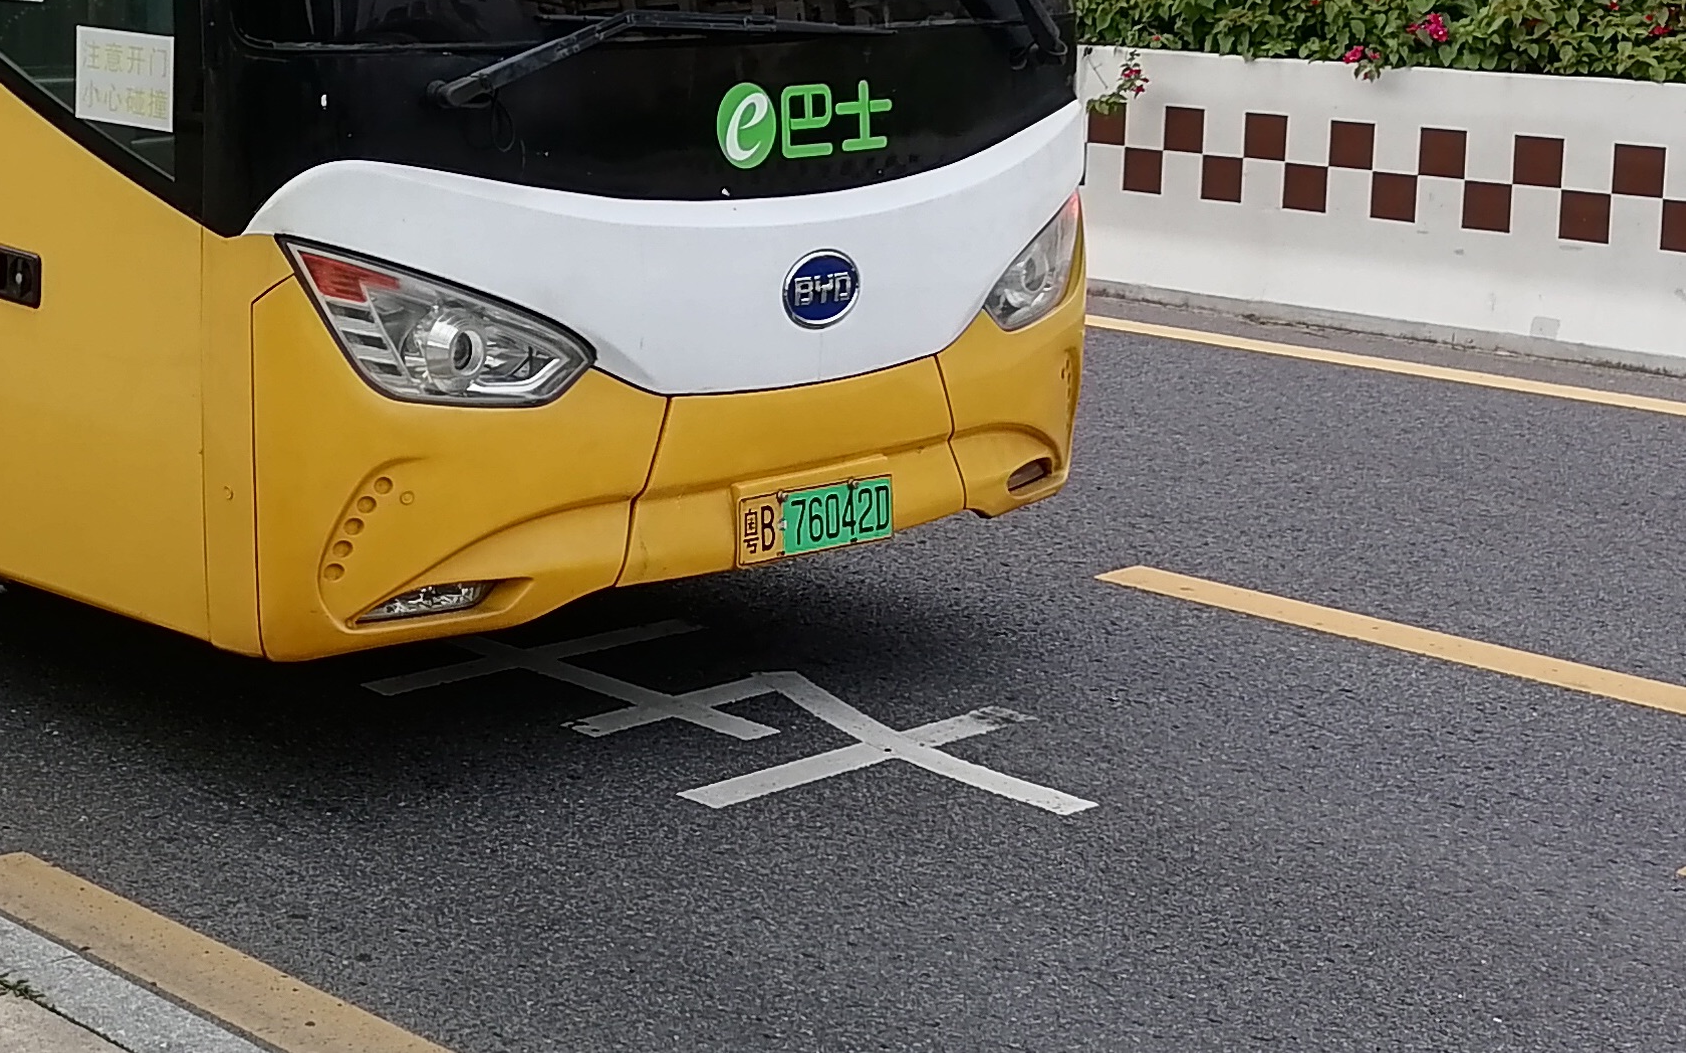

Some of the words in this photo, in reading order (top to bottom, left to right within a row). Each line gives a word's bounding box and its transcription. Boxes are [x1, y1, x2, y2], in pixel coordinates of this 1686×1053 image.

[81, 39, 168, 79] 注意开门
[81, 79, 169, 121] 小心碰撞
[794, 271, 852, 307] BYD
